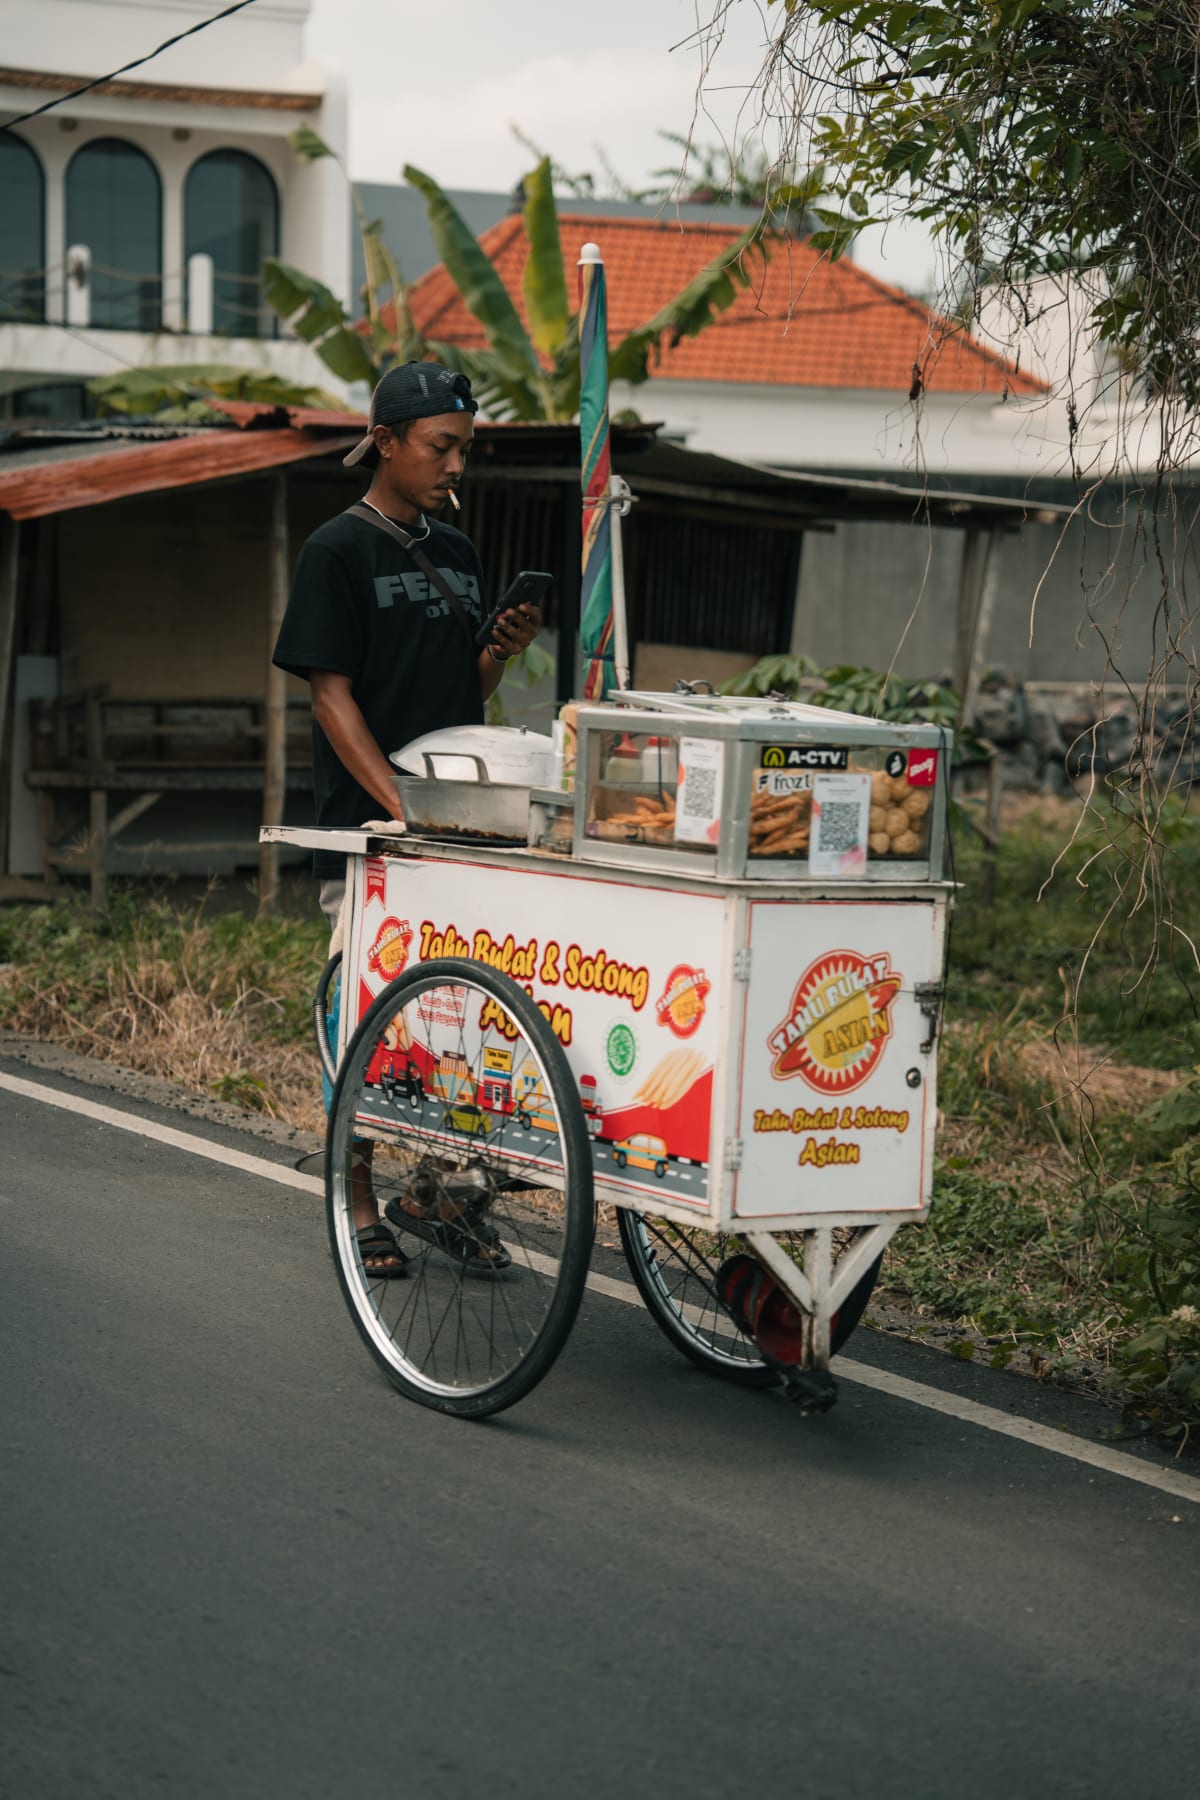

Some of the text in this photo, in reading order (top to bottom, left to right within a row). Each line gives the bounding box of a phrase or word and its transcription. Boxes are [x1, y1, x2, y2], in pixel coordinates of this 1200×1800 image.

[788, 750, 842, 766] A-CTV
[420, 921, 650, 1013] Tahu Bulat & Sotong
[824, 957, 888, 1011] BULAT
[823, 1008, 890, 1059] ASIAN
[753, 1108, 791, 1133] Tahu
[791, 1107, 839, 1134] Bulat
[854, 1105, 910, 1134] Sotong
[798, 1136, 861, 1169] Asian
